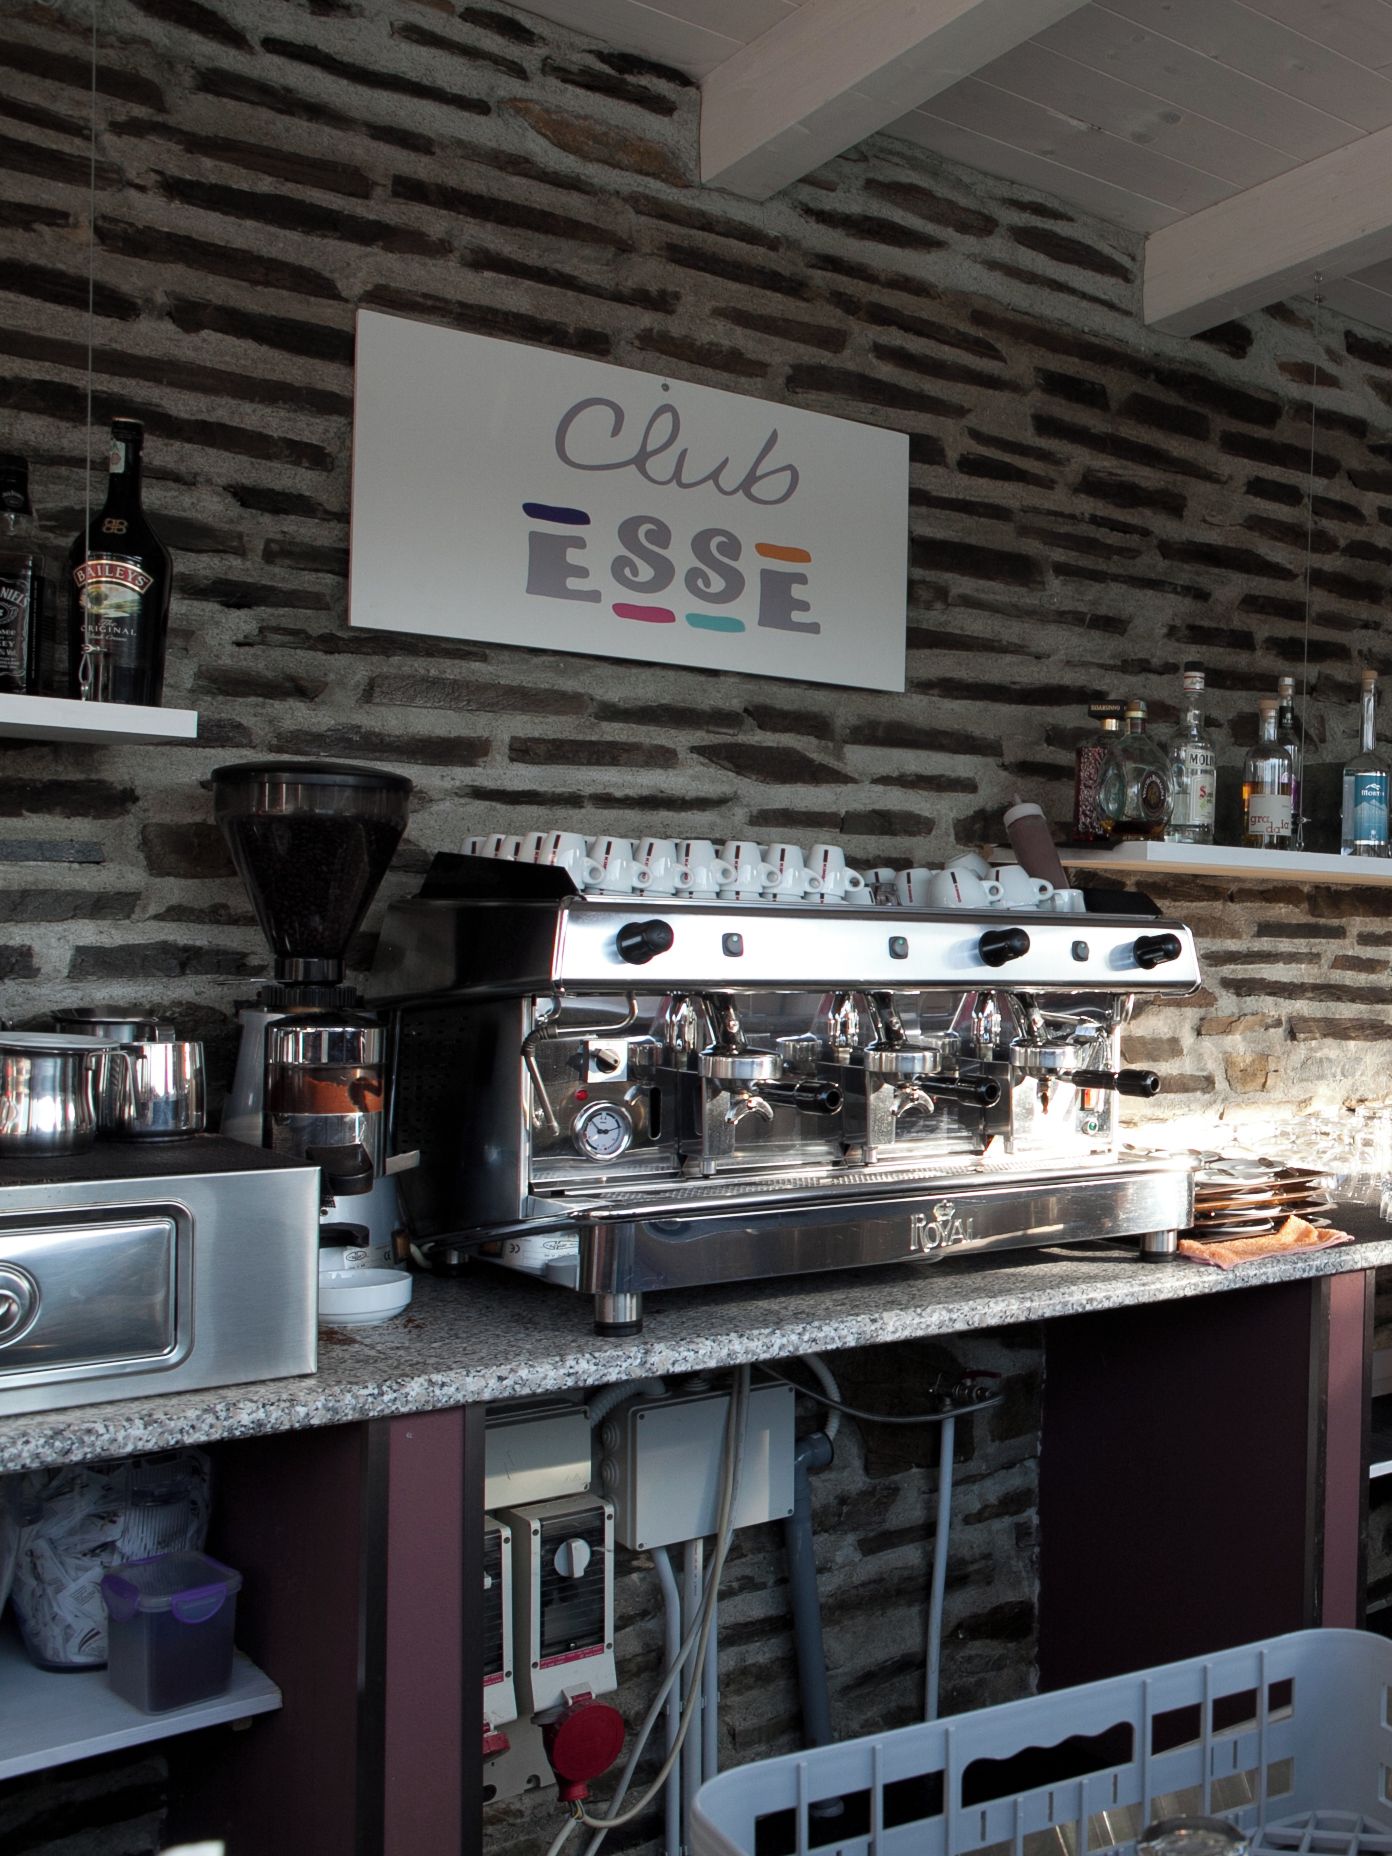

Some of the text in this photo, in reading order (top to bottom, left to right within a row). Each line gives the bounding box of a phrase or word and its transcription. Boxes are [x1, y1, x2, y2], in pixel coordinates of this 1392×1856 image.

[554, 396, 800, 506] Club
[77, 565, 147, 587] BAILEYS
[525, 511, 822, 635] ESSE
[80, 625, 137, 636] ORIGINAL
[910, 1213, 979, 1252] ROYAL
